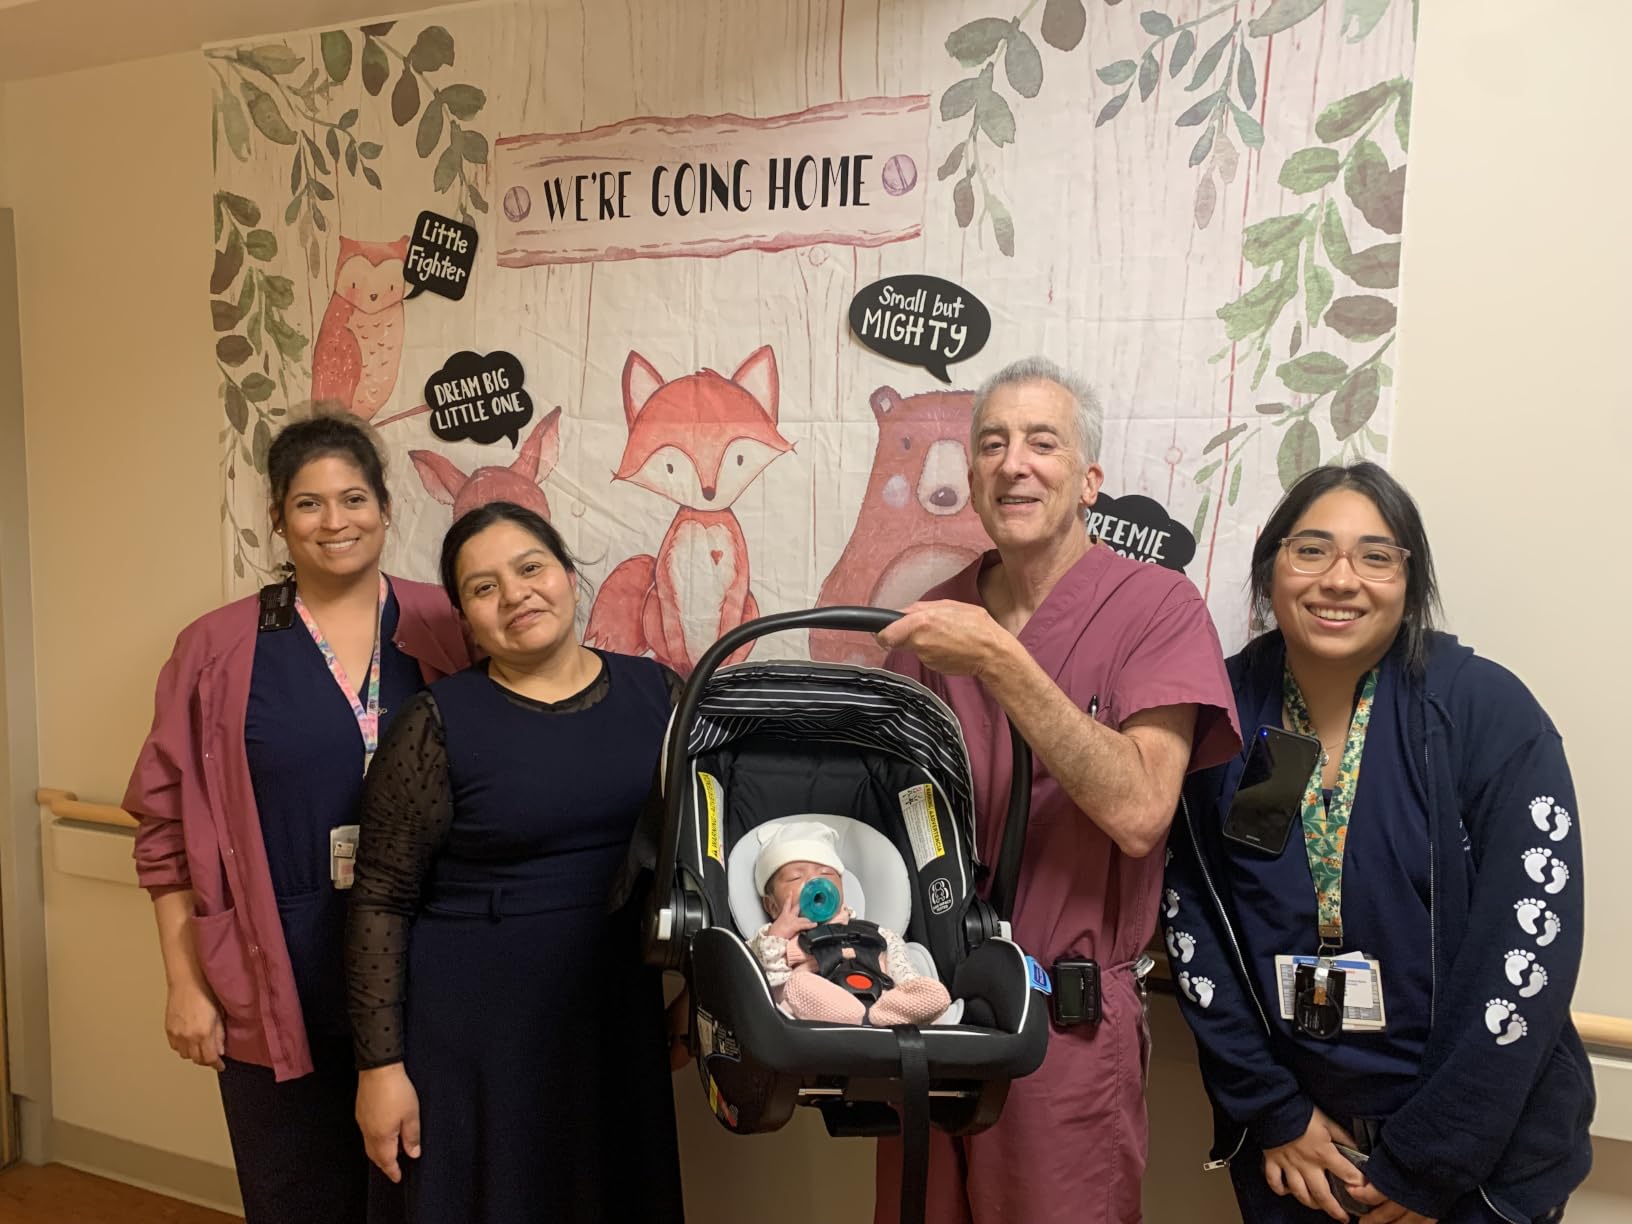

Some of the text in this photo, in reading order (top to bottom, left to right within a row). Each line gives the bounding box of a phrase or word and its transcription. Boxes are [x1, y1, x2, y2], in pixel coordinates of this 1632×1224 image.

[544, 155, 873, 224] WE'RE GOING HOME
[422, 219, 469, 254] Little
[407, 245, 466, 283] Fighter
[879, 285, 966, 318] Small but
[861, 307, 968, 358] MIGHTY
[433, 368, 510, 406] DREAM BIG
[435, 392, 525, 430] LITTLE ONE
